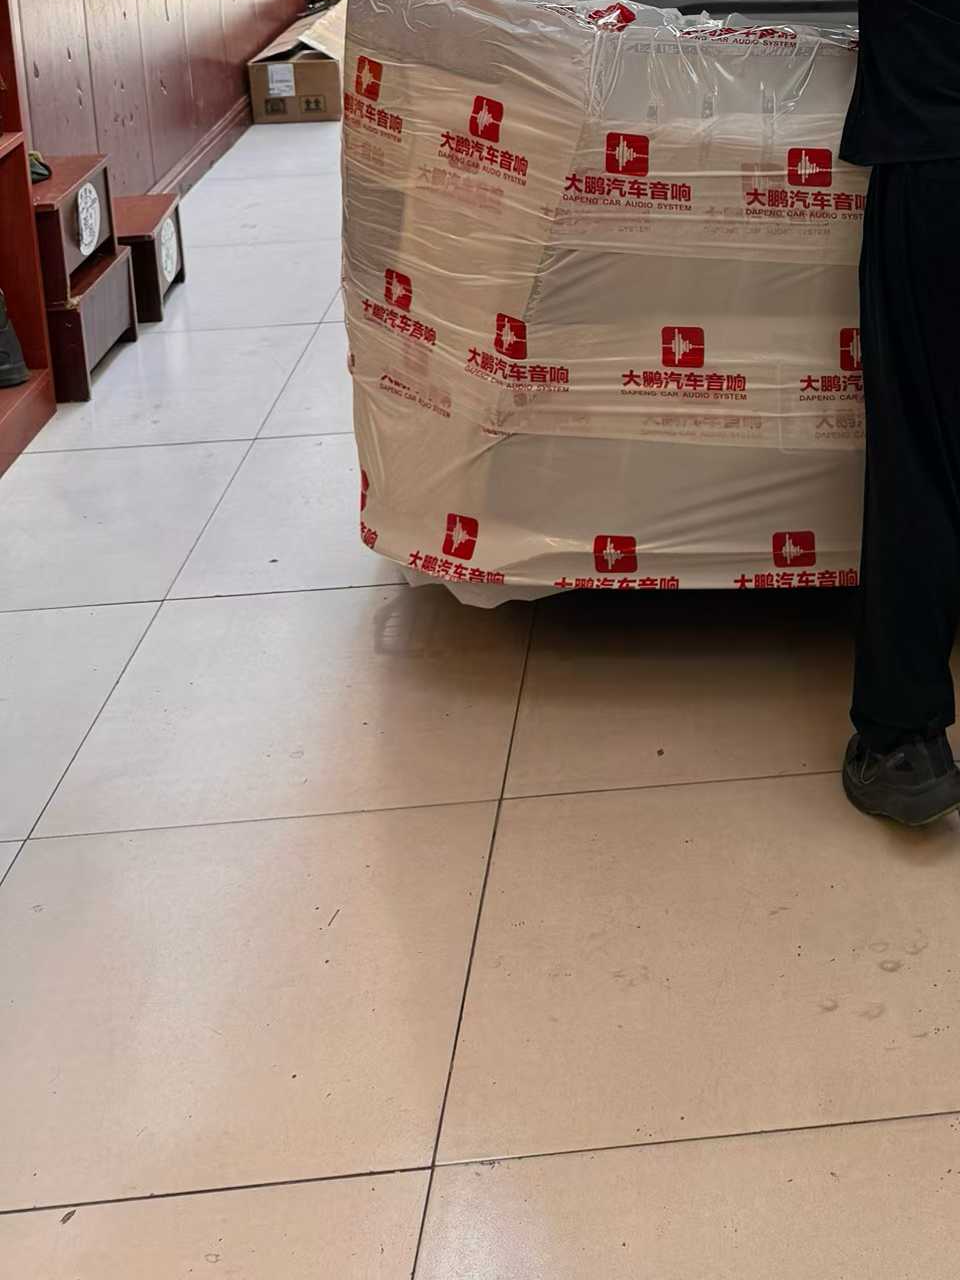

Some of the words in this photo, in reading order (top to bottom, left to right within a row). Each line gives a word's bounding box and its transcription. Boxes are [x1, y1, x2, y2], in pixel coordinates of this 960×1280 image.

[733, 37, 759, 46] AUDIO
[762, 39, 797, 49] SYSTEM
[440, 131, 529, 177] 大鹏汽车音响
[565, 174, 691, 202] 大鹏汽车音响
[562, 194, 599, 205] DAPENG
[602, 198, 621, 206] CAR
[625, 200, 653, 209] AUDIO
[657, 202, 692, 212] SYSTEM
[468, 347, 570, 384] 大鹏汽车音响
[622, 370, 746, 392] 大鹏汽车音响
[800, 375, 864, 393] 大鹏汽
[660, 390, 679, 398] CAR
[682, 391, 710, 399] AUDIO
[713, 392, 747, 401] SYSTEM
[839, 394, 859, 402] CAR
